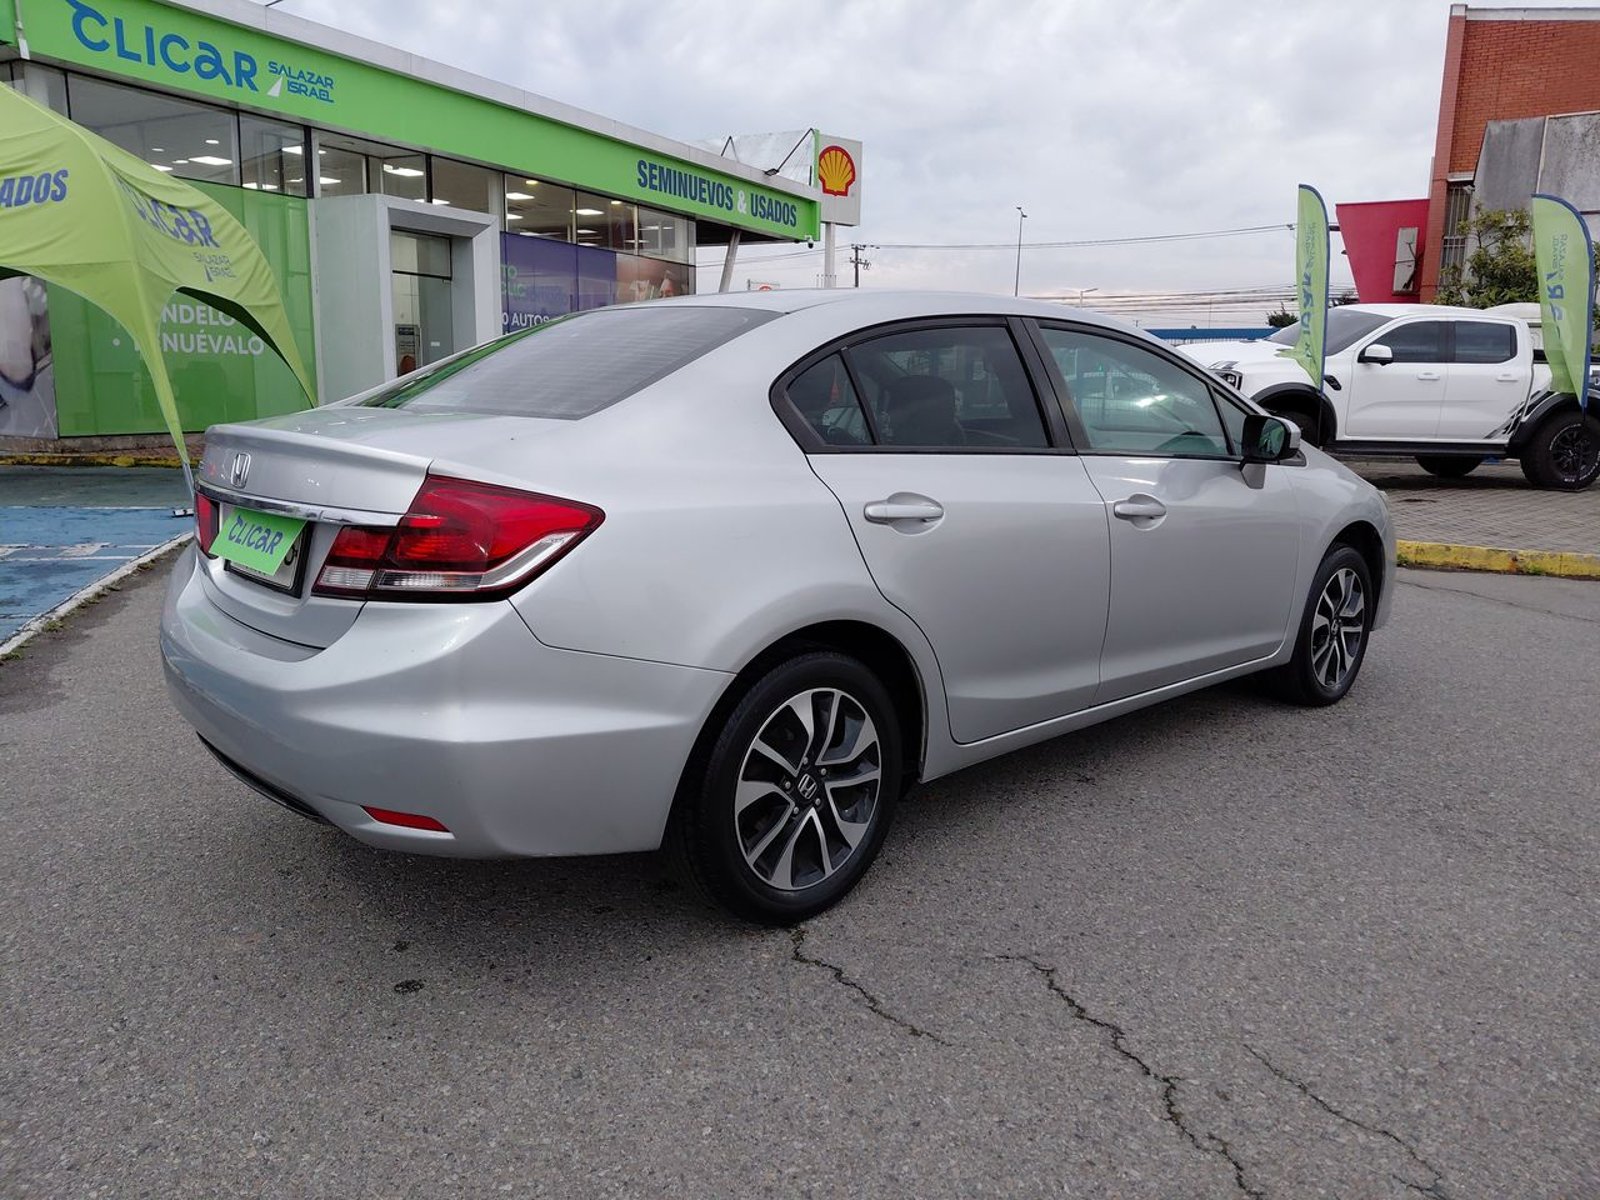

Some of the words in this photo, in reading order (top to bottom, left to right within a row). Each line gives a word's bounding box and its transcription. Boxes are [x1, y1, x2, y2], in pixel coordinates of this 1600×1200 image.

[268, 61, 335, 90] SALAZAR
[287, 80, 335, 104] ISRAEL
[636, 159, 734, 211] SEMINUEVOS
[737, 190, 747, 214] &
[750, 193, 797, 227] USADOS
[134, 329, 265, 355] NUÉVALO
